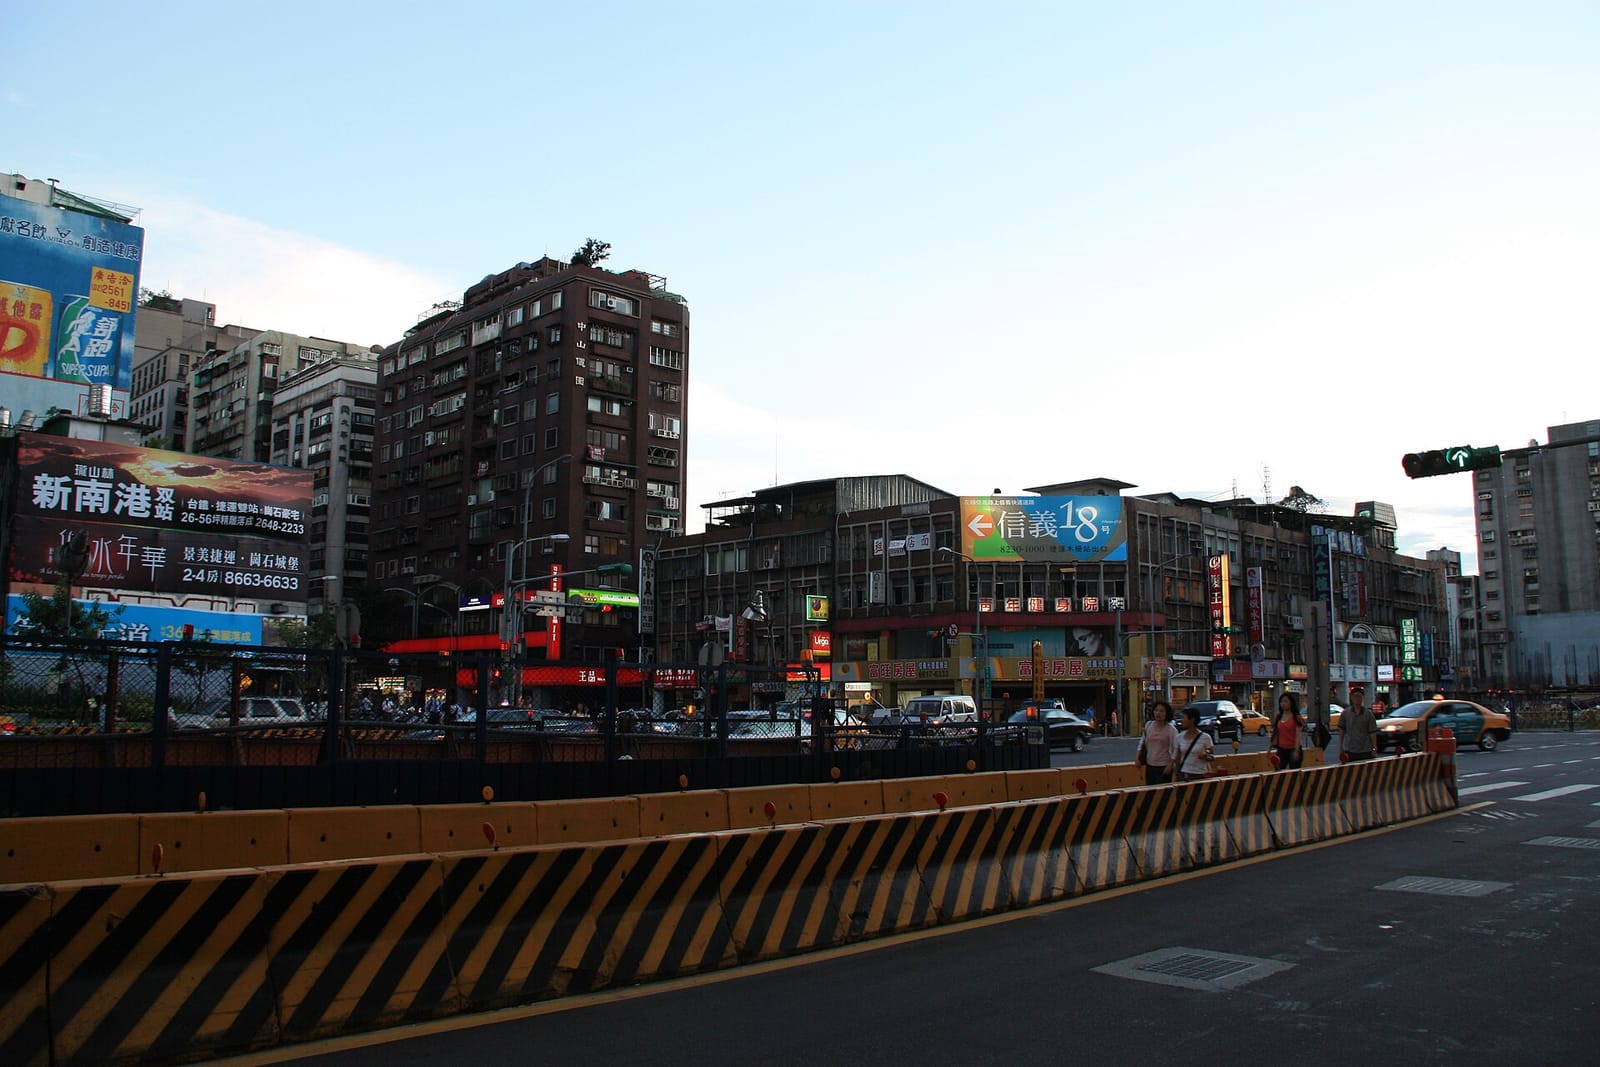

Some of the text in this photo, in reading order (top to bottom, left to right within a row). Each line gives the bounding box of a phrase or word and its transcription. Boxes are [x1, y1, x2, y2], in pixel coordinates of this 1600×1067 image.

[82, 235, 139, 262] 創造健康
[95, 270, 131, 285] 廣告洽
[104, 298, 130, 311] -8451
[82, 317, 119, 358] 舒跑
[62, 363, 86, 377] SUPER
[33, 473, 152, 518] 新南港
[255, 518, 305, 534] 2648-2233
[224, 572, 299, 590] 8663-6633
